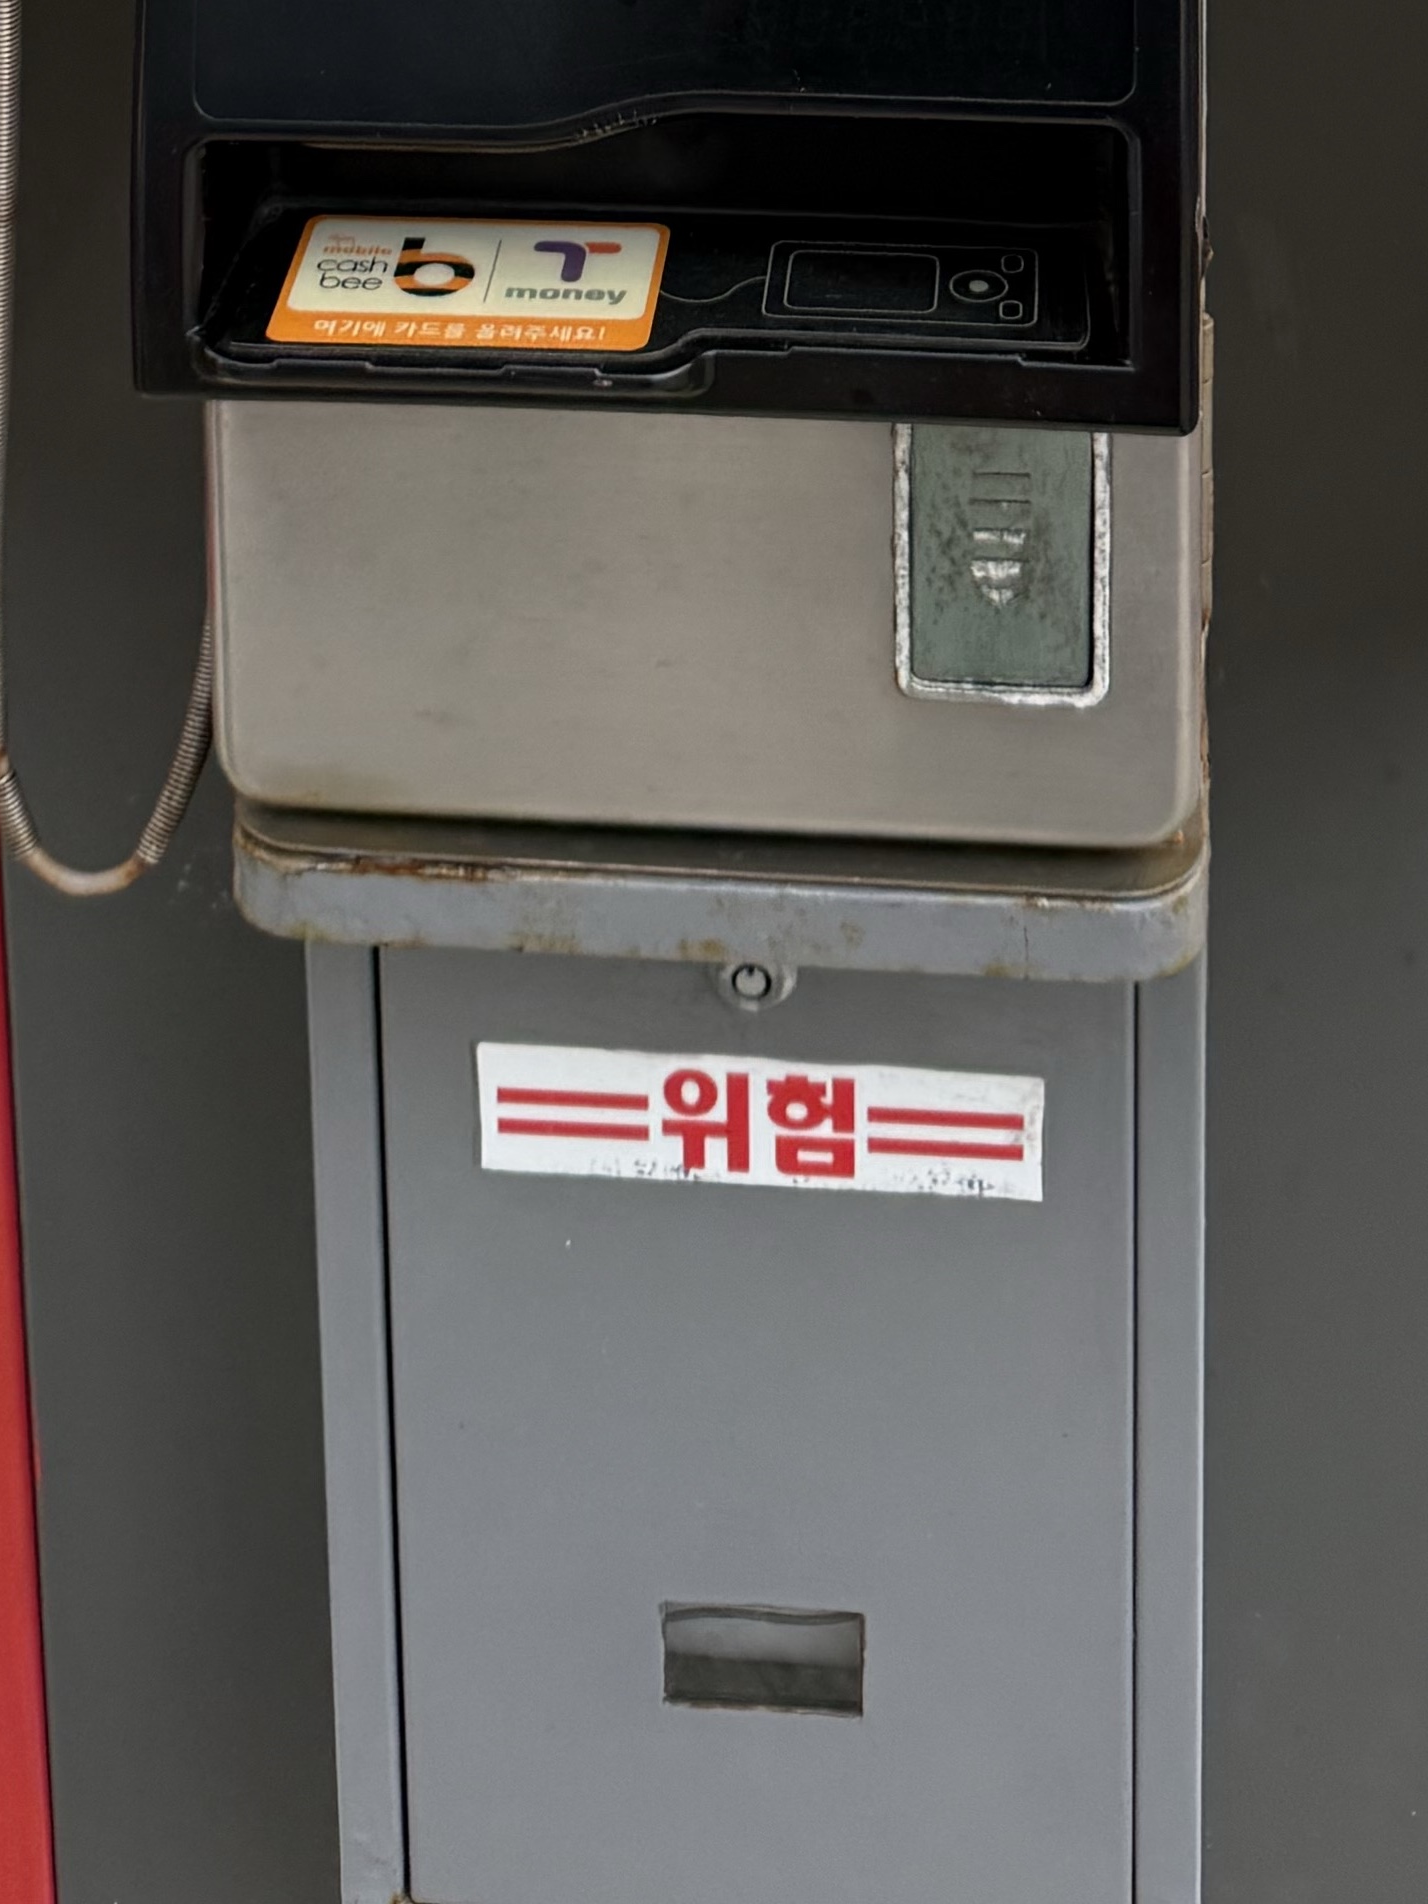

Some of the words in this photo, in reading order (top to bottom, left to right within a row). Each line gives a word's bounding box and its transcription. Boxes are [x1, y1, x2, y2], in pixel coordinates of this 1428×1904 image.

[323, 245, 393, 256] mobile
[317, 256, 389, 274] cash
[319, 271, 383, 291] bee
[504, 286, 628, 306] money
[313, 319, 387, 337] 여기에
[394, 320, 465, 340] 카드를
[474, 322, 606, 343] 올려주세요!
[661, 1068, 856, 1179] 위험
